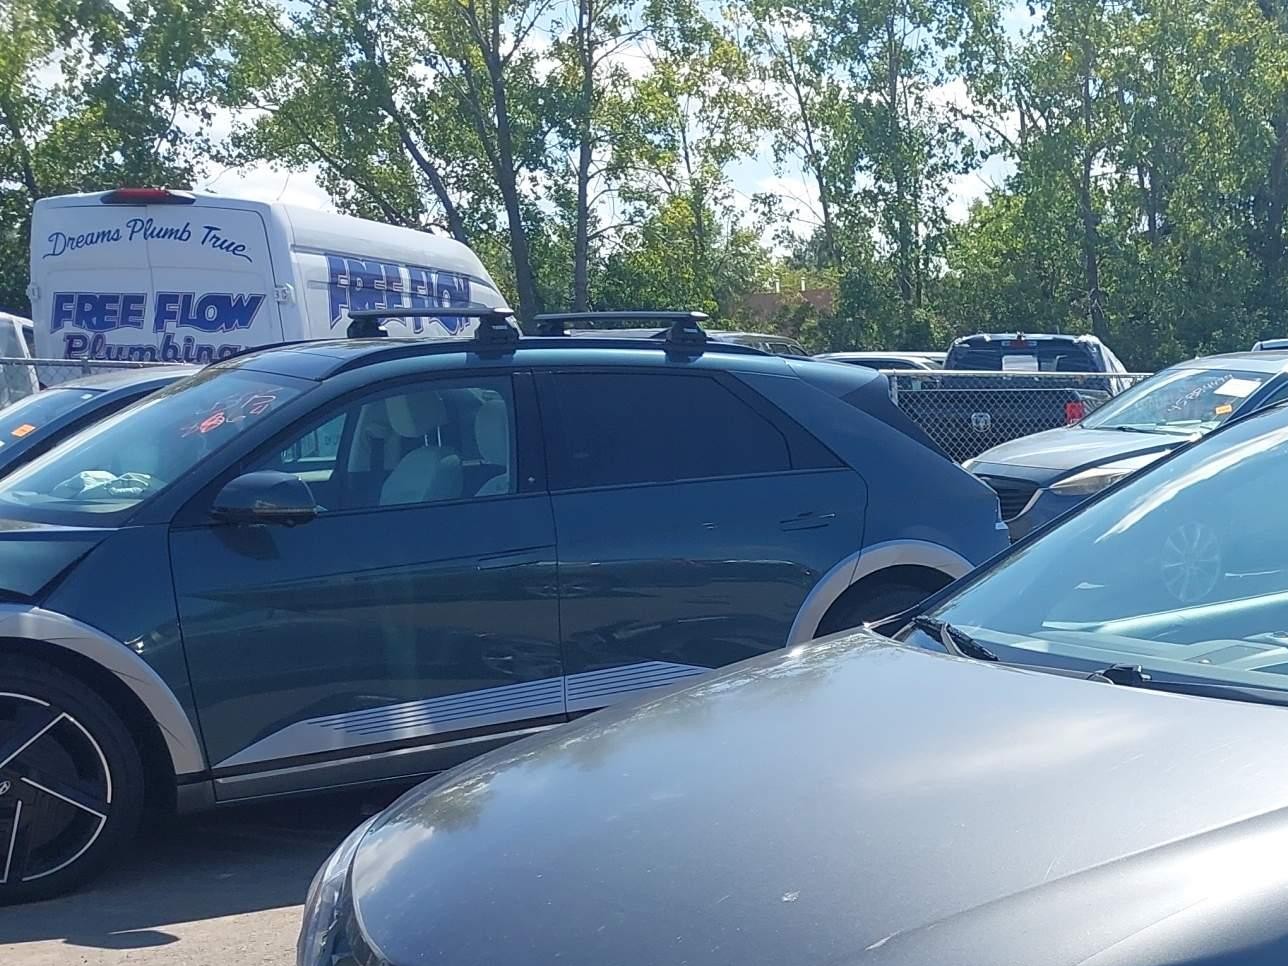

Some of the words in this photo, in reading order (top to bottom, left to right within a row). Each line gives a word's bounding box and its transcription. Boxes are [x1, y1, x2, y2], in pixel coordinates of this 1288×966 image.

[43, 227, 122, 259] Dreams
[126, 218, 192, 242] Plumb
[201, 225, 253, 263] True
[50, 291, 148, 335] FREE
[153, 291, 266, 333] FLOW
[327, 254, 406, 330] FREE
[406, 266, 473, 336] FLOW
